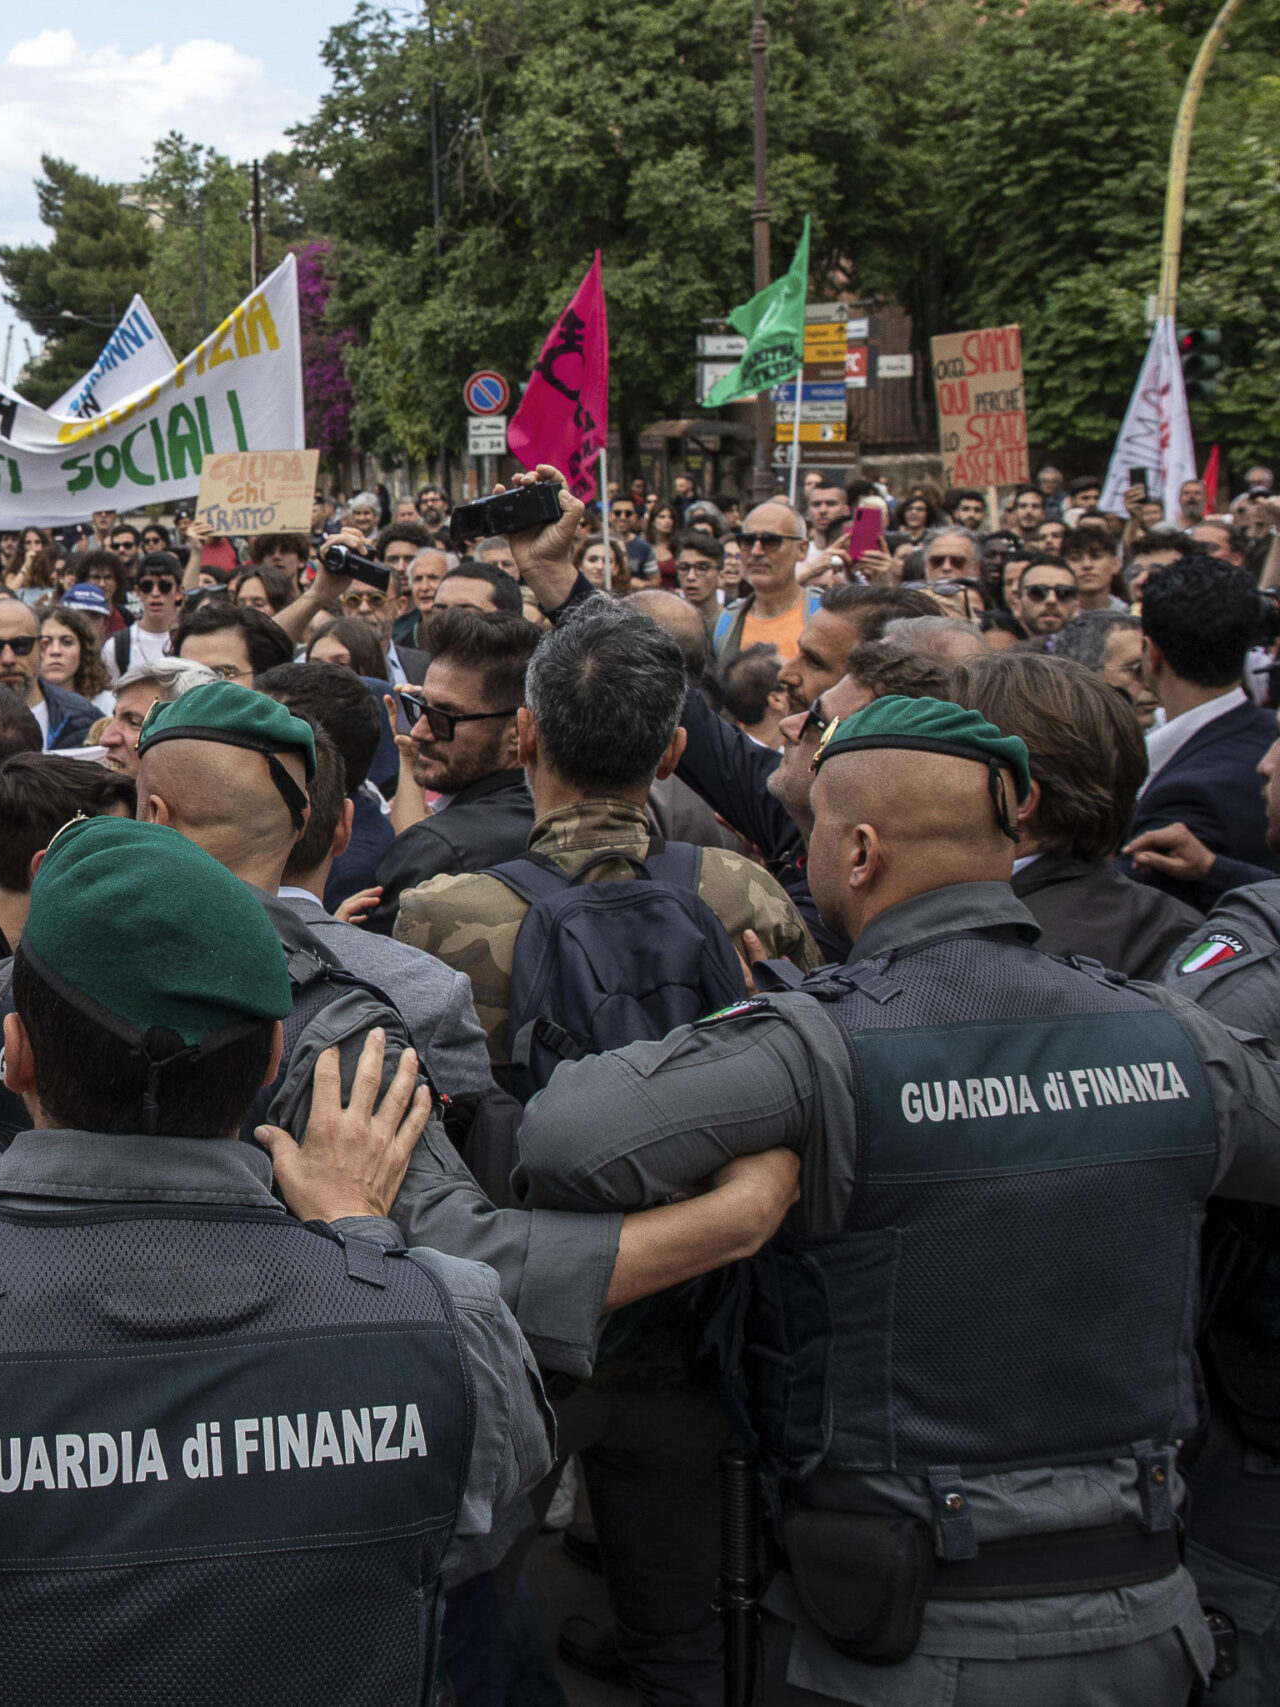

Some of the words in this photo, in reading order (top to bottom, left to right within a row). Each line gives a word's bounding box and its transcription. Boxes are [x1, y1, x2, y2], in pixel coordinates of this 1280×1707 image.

[963, 328, 1020, 376] SIAMO
[966, 411, 1027, 450] STATO
[954, 448, 1029, 487] ASSENTE
[227, 481, 267, 504] chi
[901, 1074, 1041, 1124] GUARDIA
[1042, 1072, 1072, 1112] di
[1068, 1061, 1190, 1109] FINANZA
[182, 1421, 223, 1480] di
[234, 1403, 428, 1475] FINANZA
